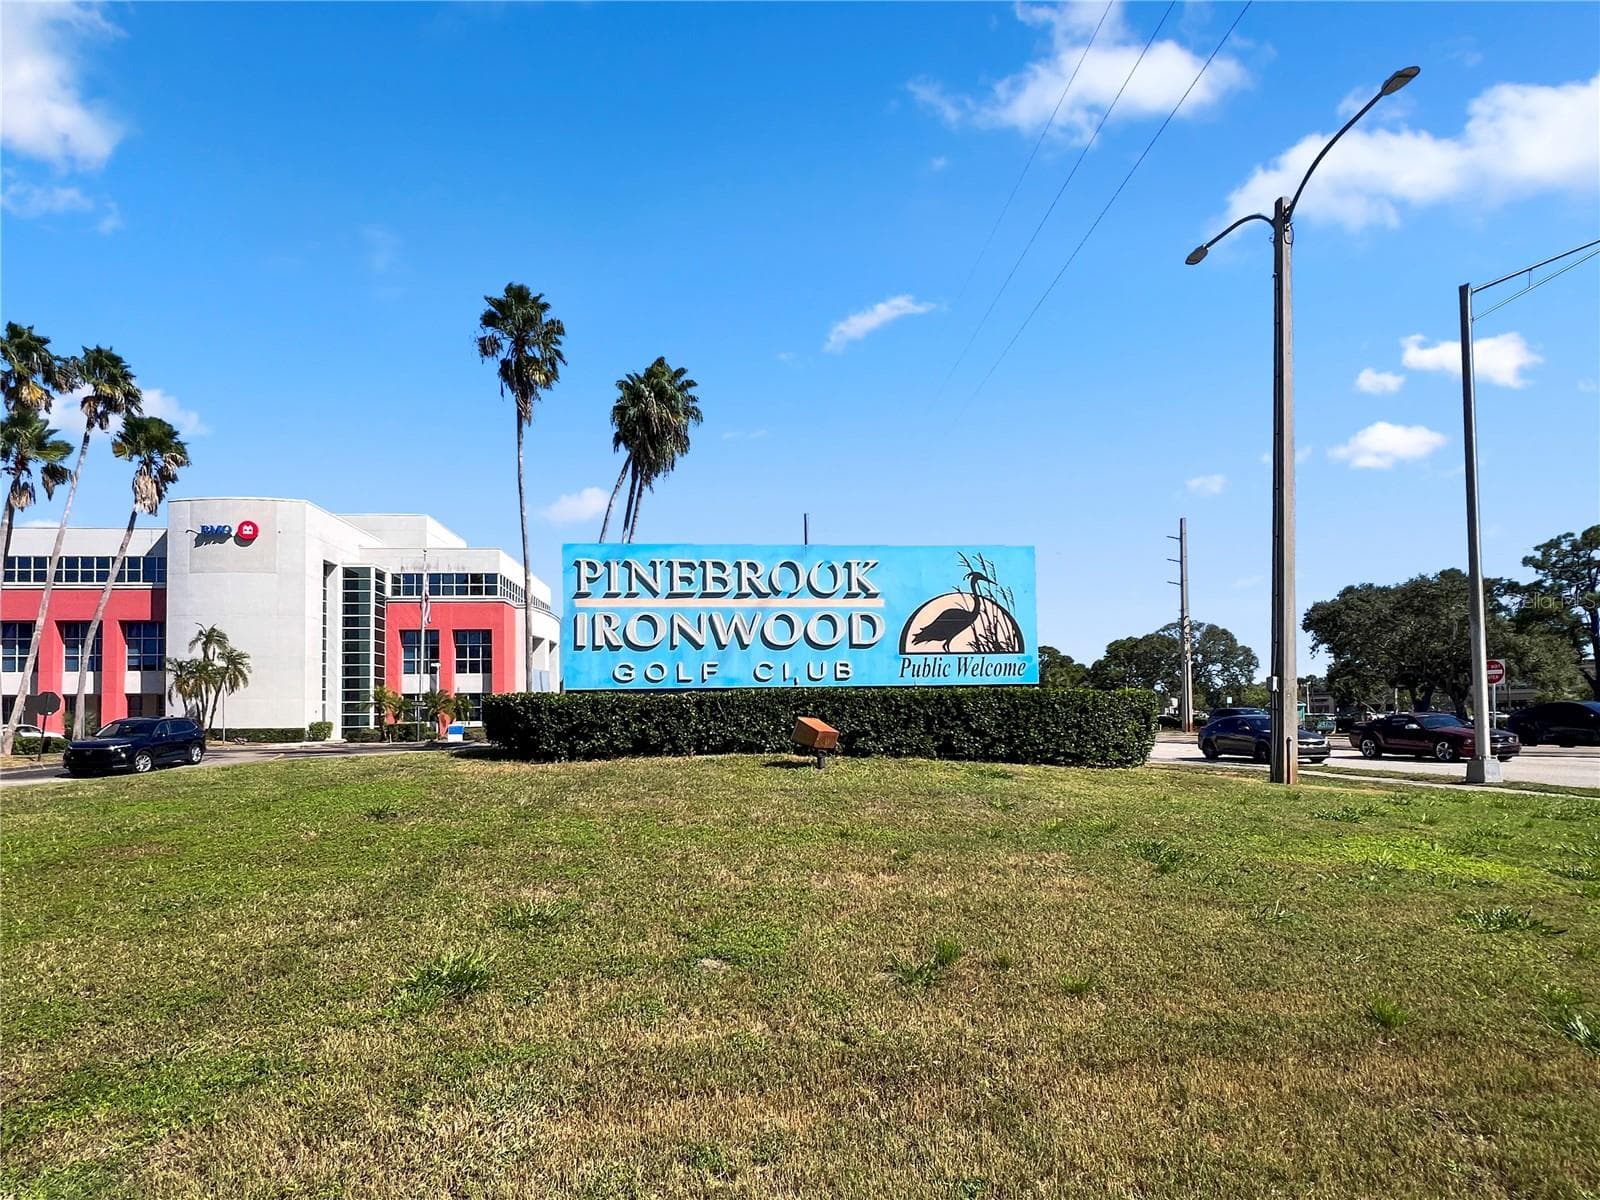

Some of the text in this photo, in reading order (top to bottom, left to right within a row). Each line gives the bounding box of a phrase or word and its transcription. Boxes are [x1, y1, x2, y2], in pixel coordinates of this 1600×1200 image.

[200, 524, 233, 535] BMO
[572, 558, 880, 599] PINEBROOK
[573, 611, 886, 651] IRONWOOD
[612, 660, 852, 684] GOLF CLUB
[899, 656, 1027, 678] Public Welcome
